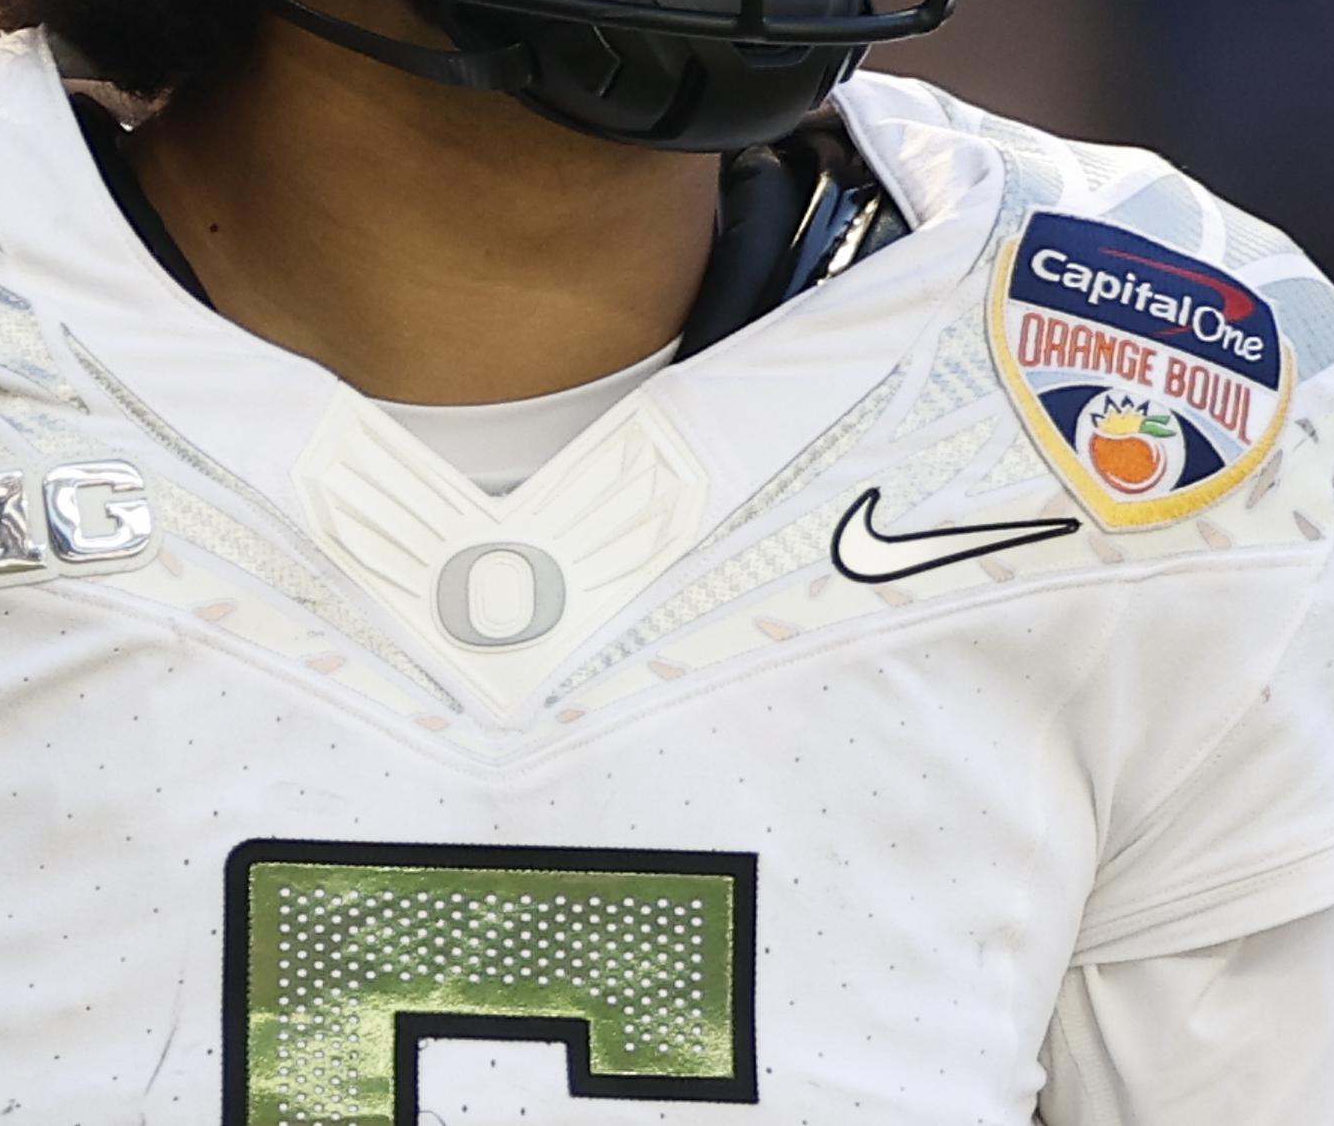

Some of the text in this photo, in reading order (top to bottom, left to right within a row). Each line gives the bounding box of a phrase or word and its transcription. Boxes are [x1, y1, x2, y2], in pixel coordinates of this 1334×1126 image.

[1017, 312, 1253, 446] ORANGE BOWL
[436, 541, 567, 648] O
